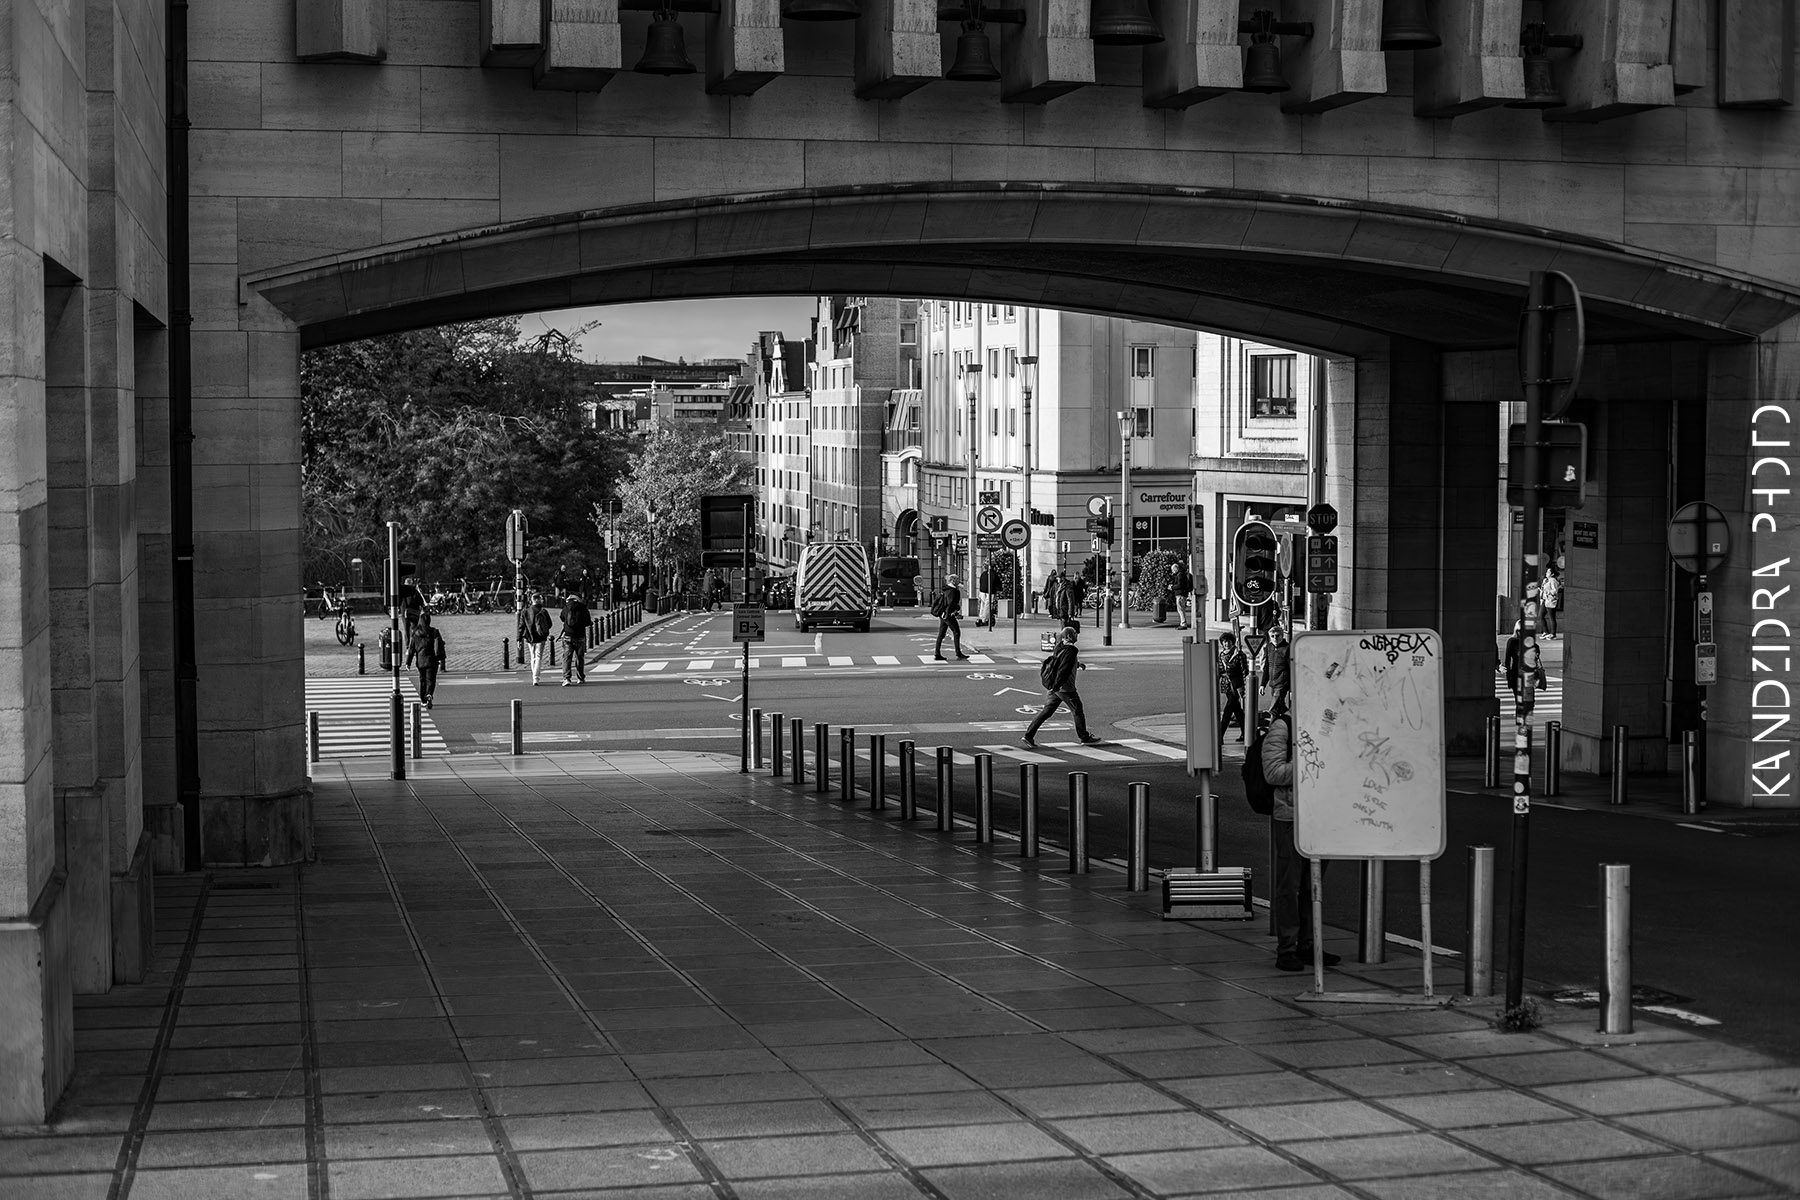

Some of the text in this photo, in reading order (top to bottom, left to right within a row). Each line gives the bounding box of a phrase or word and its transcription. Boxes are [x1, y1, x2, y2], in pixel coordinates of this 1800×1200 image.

[1140, 492, 1186, 503] Carrefour
[1309, 513, 1337, 525] STOP
[936, 539, 944, 549] P
